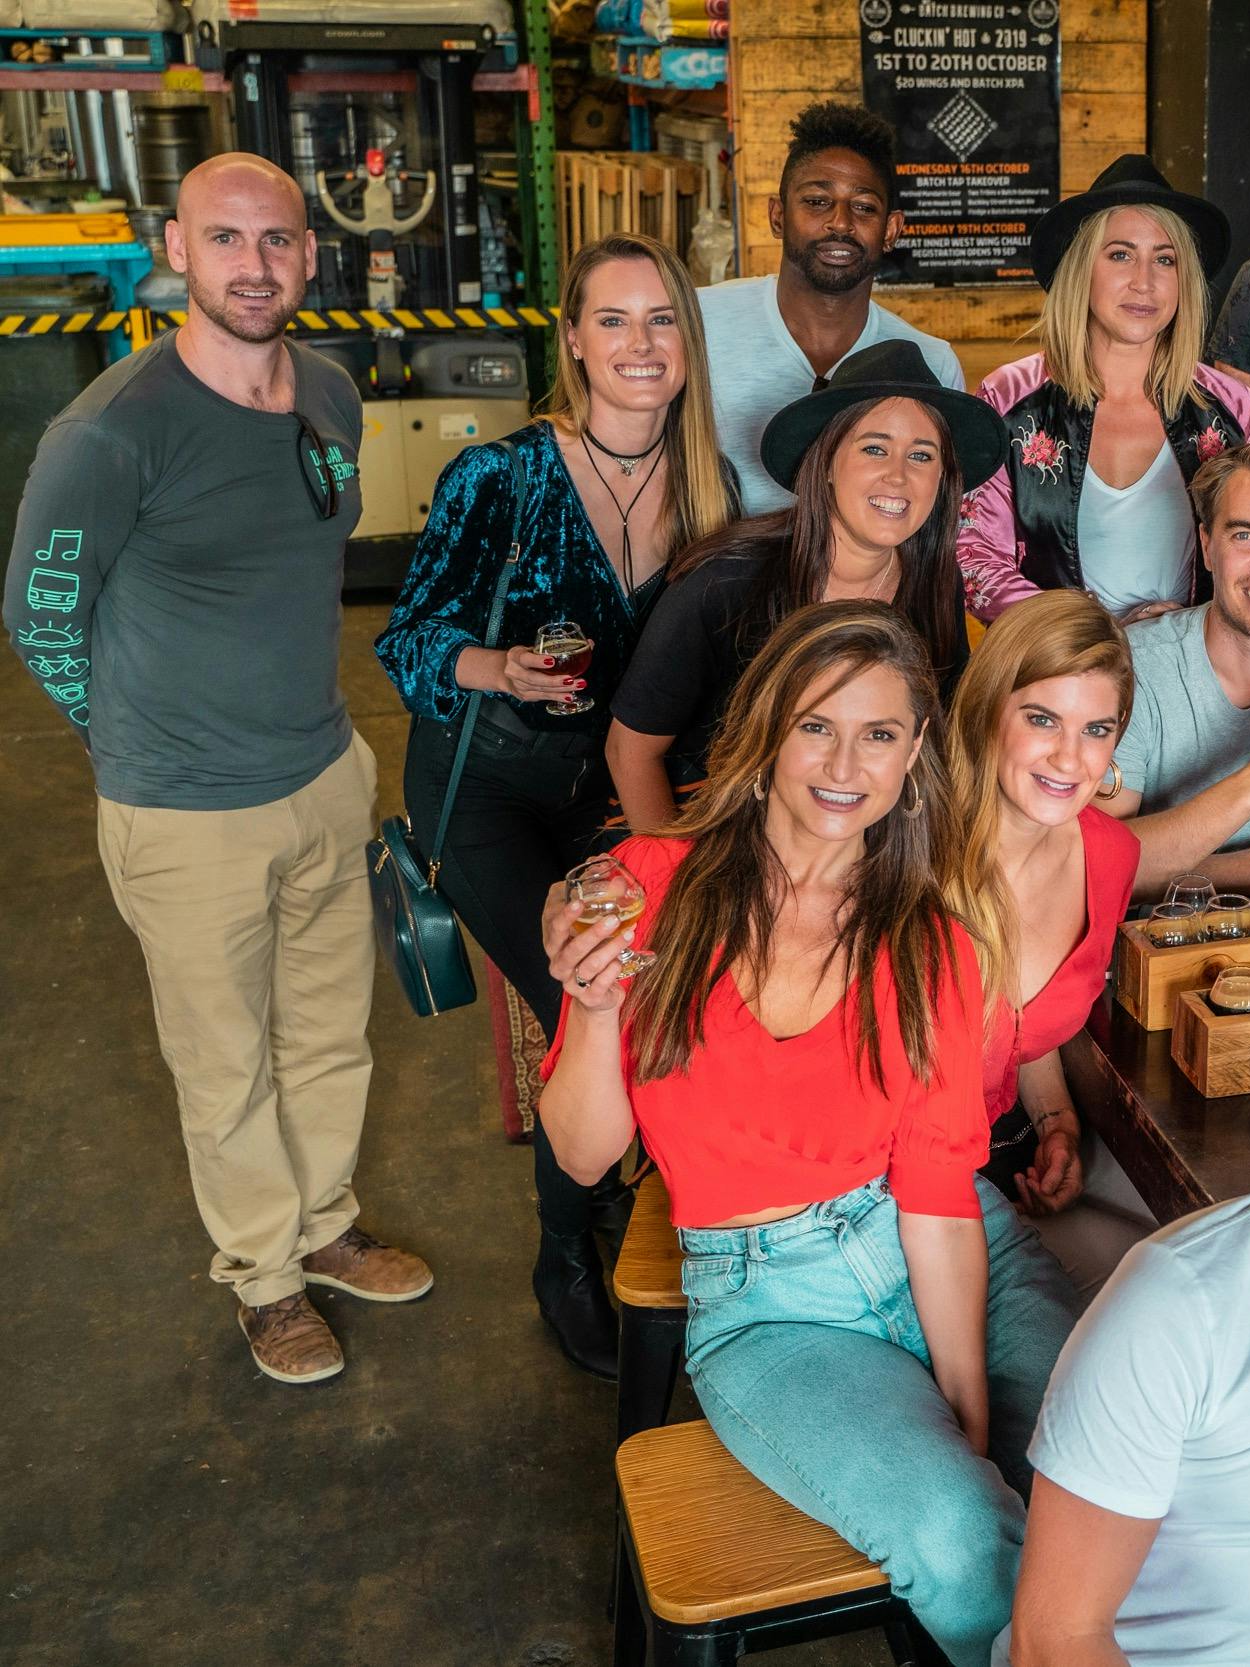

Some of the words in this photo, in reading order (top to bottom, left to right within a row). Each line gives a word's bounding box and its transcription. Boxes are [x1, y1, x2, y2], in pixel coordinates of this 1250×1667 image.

[950, 5, 993, 19] BREWING
[894, 27, 950, 48] CLUCKIN'
[953, 28, 977, 48] HOT
[995, 29, 1027, 48] 2019
[874, 54, 903, 71] 1ST
[905, 55, 928, 71] TO
[930, 55, 973, 71] 20TH
[976, 55, 1047, 72] OCTOBER
[896, 76, 915, 90] $20
[916, 77, 949, 90] WINGS
[950, 78, 971, 90] AND
[972, 78, 1004, 90] BATCH
[1004, 77, 1025, 89] XPA
[896, 164, 958, 175] WEDNESDAY
[985, 163, 1030, 174] OCTOBER
[916, 177, 946, 187] BATCH
[948, 177, 965, 187] TAP
[966, 176, 1010, 187] TAKEOVER
[902, 225, 955, 235] SATURDAY
[957, 224, 981, 234] 19TH
[982, 223, 1026, 234] OCTOBER
[895, 238, 922, 249] GREAT
[923, 238, 950, 248] INNER
[951, 237, 975, 248] WEST
[976, 237, 1000, 247] WING
[912, 248, 966, 258] REGISTRATION
[967, 248, 993, 257] OPENS
[1003, 247, 1017, 256] SEP
